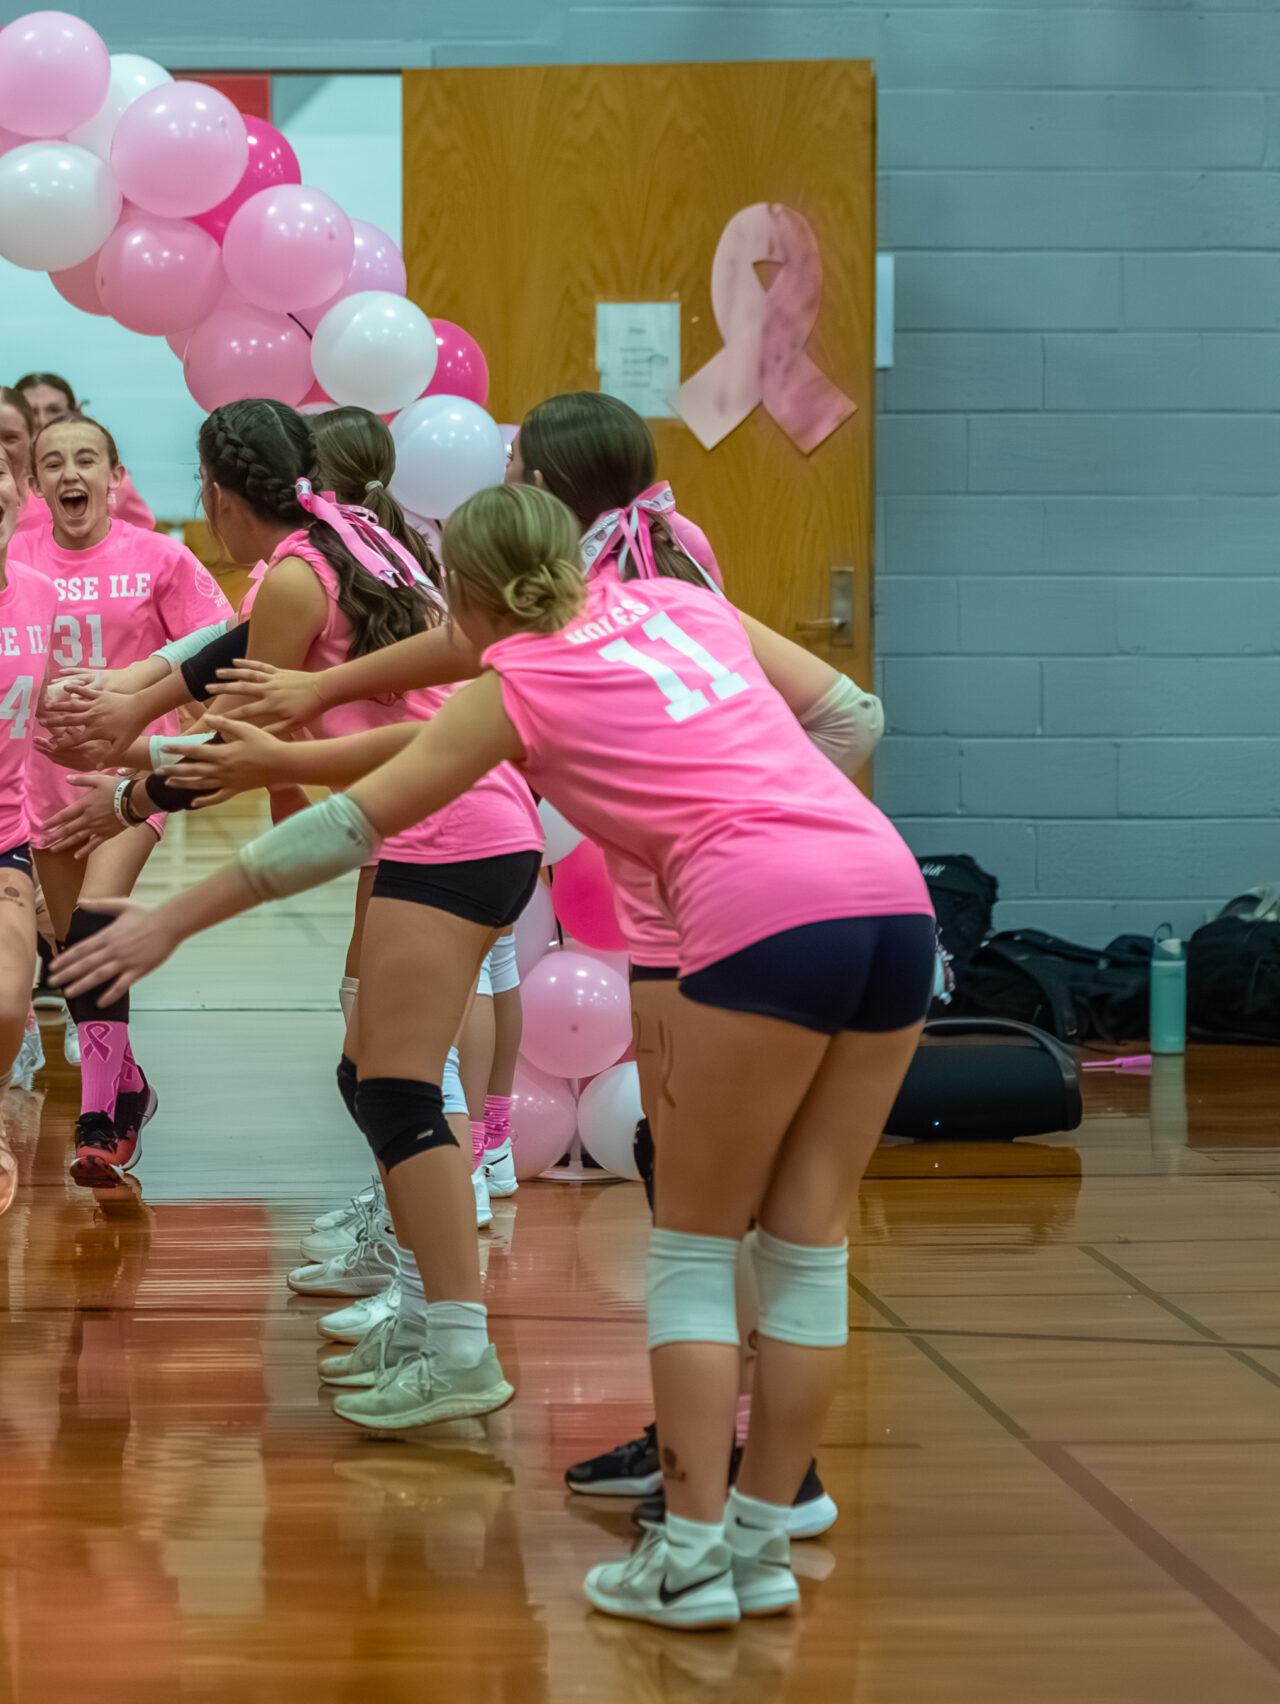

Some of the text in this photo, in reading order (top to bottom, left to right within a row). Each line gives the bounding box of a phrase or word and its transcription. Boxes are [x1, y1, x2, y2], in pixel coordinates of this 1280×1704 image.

[109, 573, 151, 598] ILE
[53, 614, 107, 667] 31
[598, 611, 750, 722] 11
